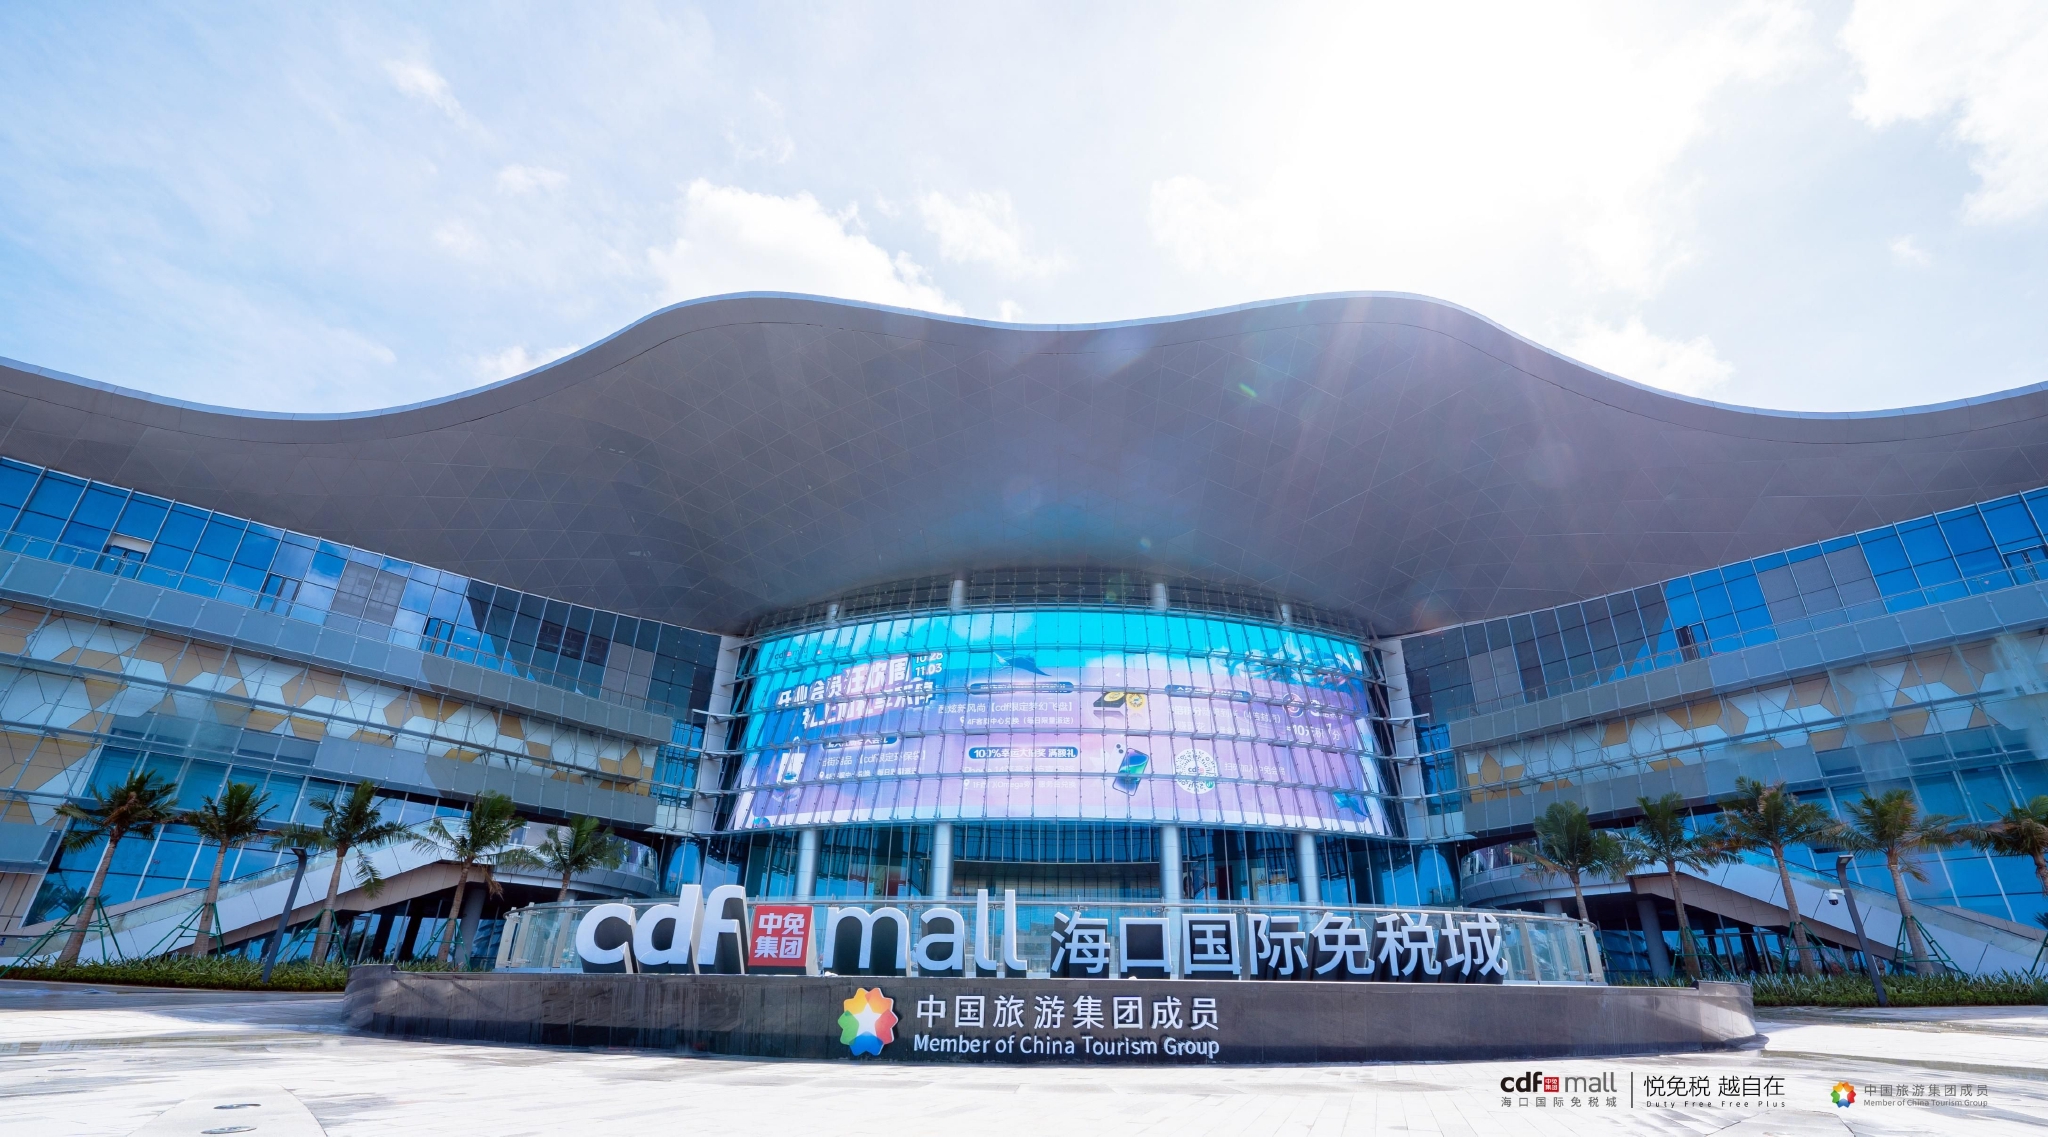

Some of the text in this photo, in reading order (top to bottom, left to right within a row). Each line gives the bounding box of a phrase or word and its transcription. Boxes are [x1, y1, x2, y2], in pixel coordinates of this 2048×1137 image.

[916, 652, 943, 664] 1028
[576, 885, 746, 966] cdf
[758, 912, 805, 935] 中免
[823, 889, 1027, 971] mall
[755, 936, 802, 959] 集团
[1050, 911, 1508, 977] 海口国际免税城
[916, 995, 1219, 1031] 中国旅游集团成员
[913, 1034, 1220, 1059] Member of China Tourism Group
